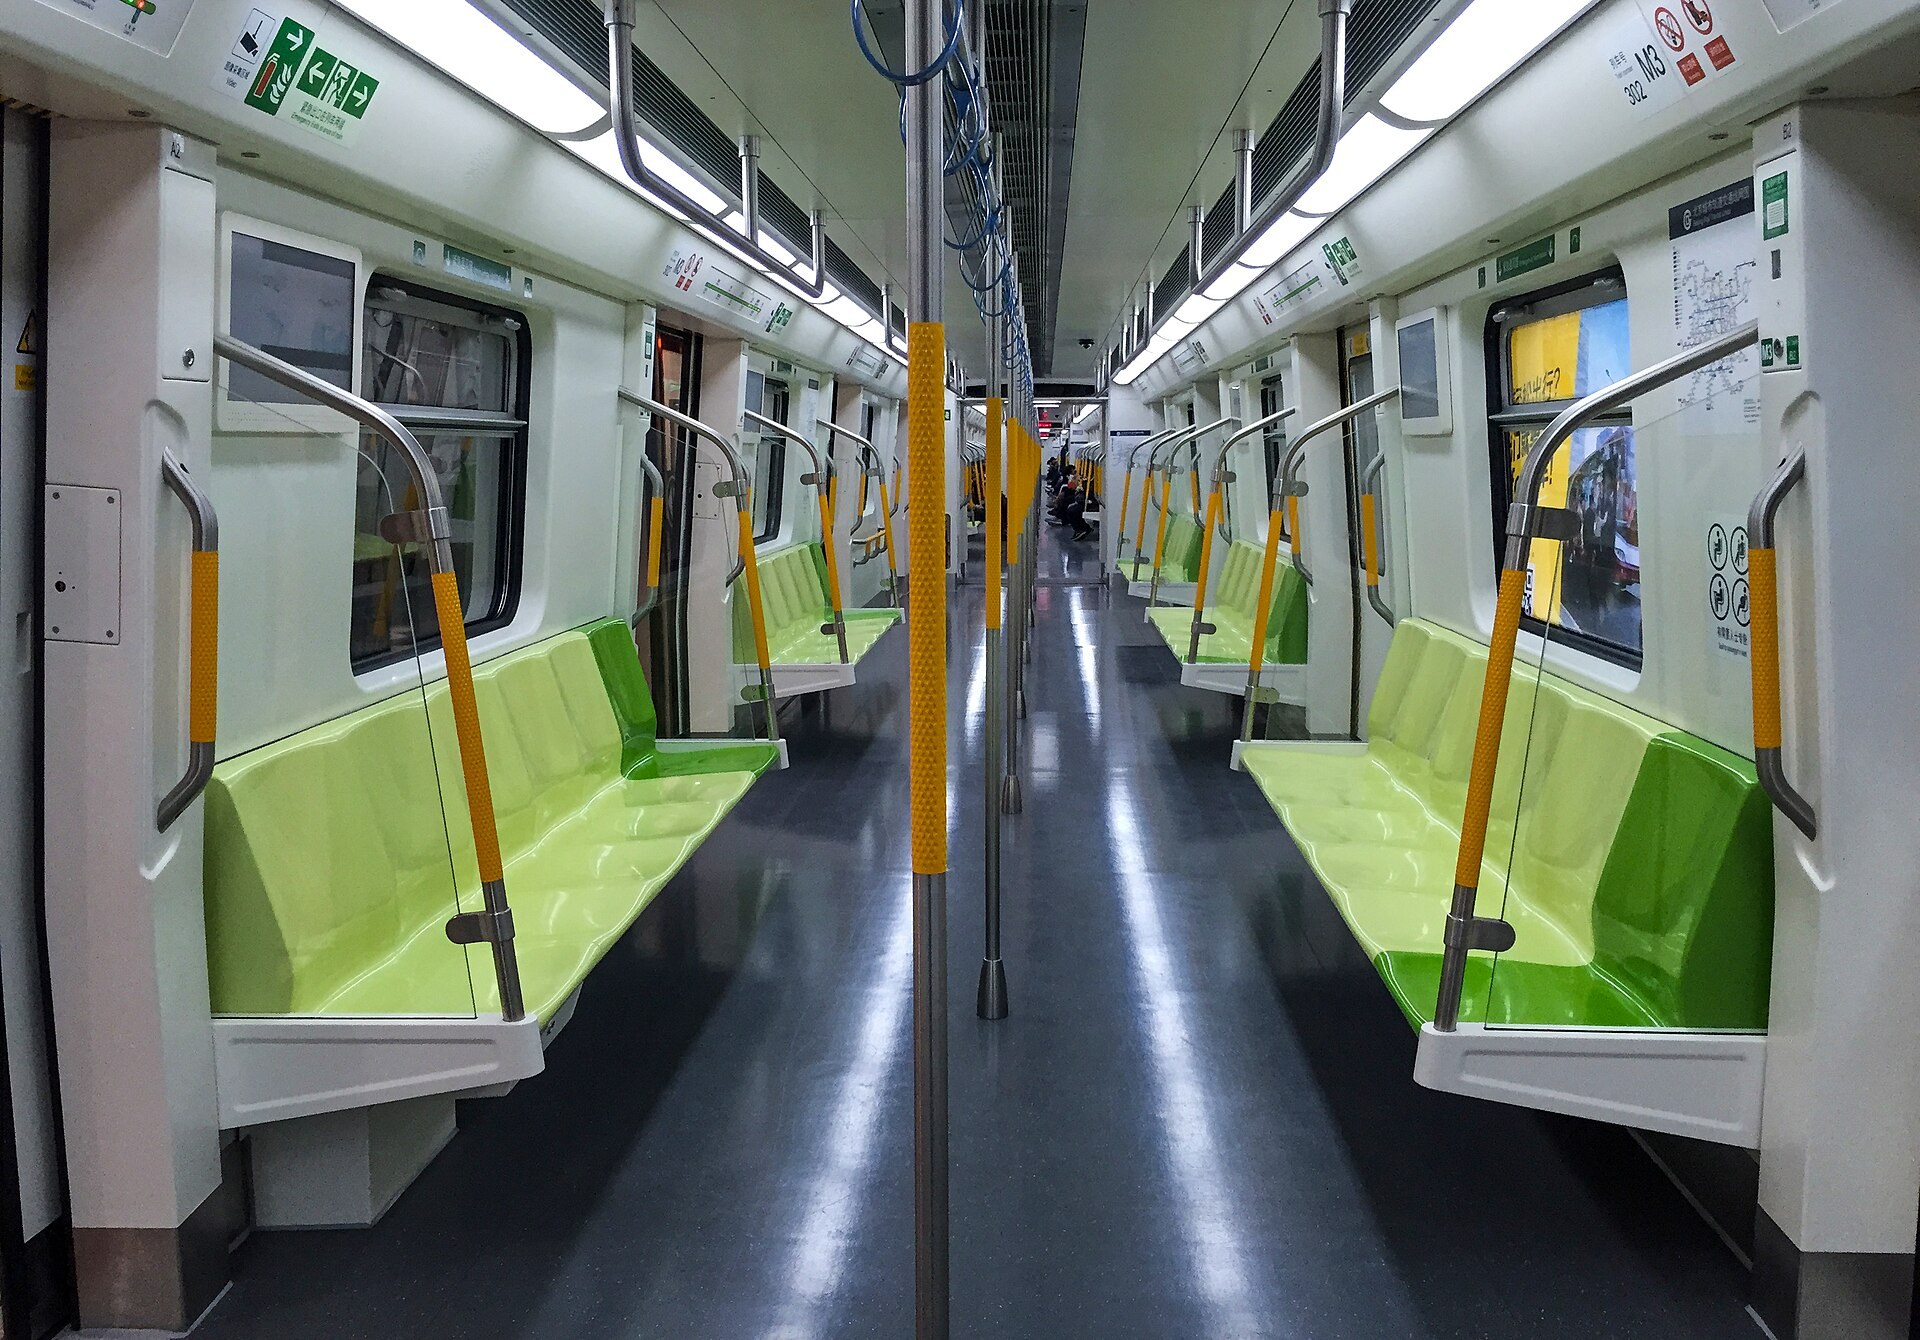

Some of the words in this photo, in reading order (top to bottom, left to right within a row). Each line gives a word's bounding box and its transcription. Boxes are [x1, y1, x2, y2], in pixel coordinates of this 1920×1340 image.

[1634, 44, 1666, 83] M3
[1623, 80, 1648, 106] 302
[1782, 121, 1792, 141] B2
[170, 141, 181, 159] A2
[1761, 343, 1773, 361] M3
